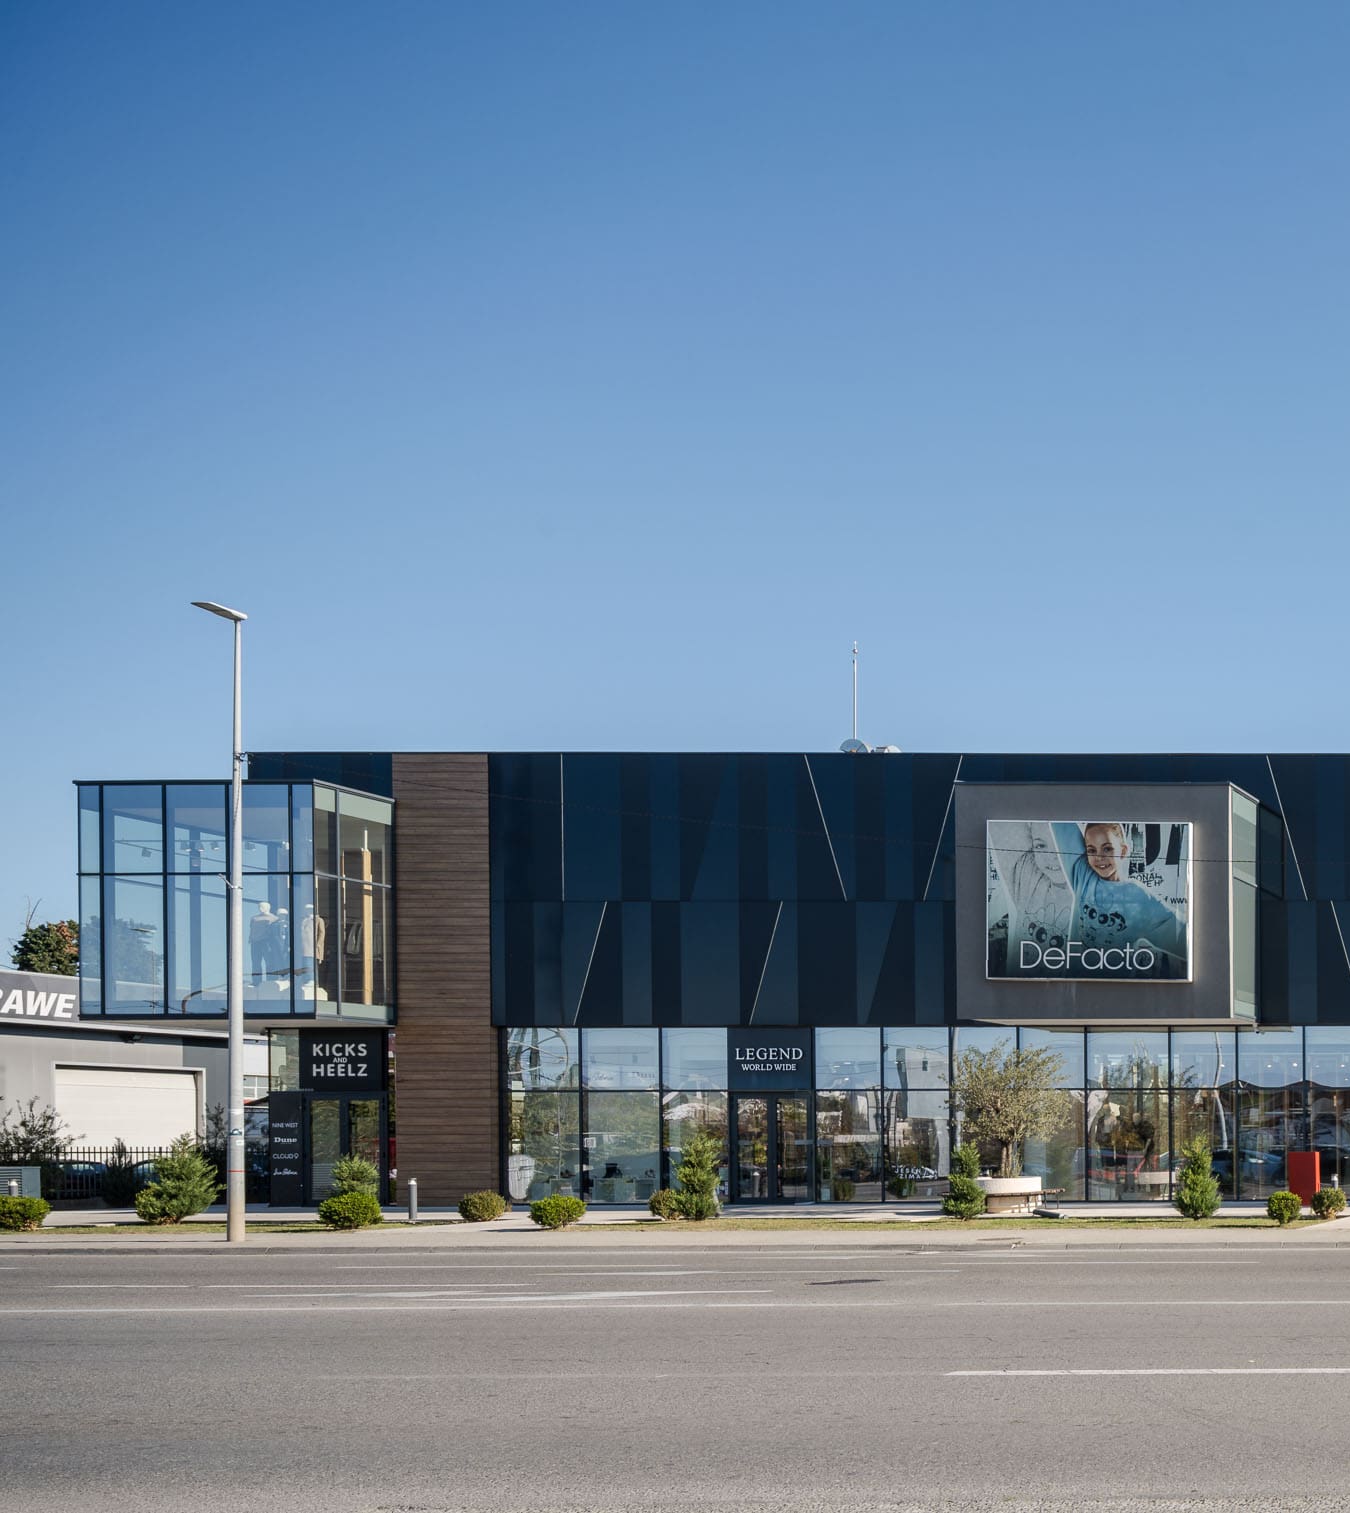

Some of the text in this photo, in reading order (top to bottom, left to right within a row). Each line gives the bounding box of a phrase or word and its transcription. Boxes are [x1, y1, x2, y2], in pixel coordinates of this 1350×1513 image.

[1020, 941, 1154, 969] DeFacto
[312, 1043, 367, 1057] KICKS
[735, 1047, 803, 1060] LEGEND
[312, 1063, 368, 1077] HEELZ
[741, 1063, 797, 1071] WORLD WIDE
